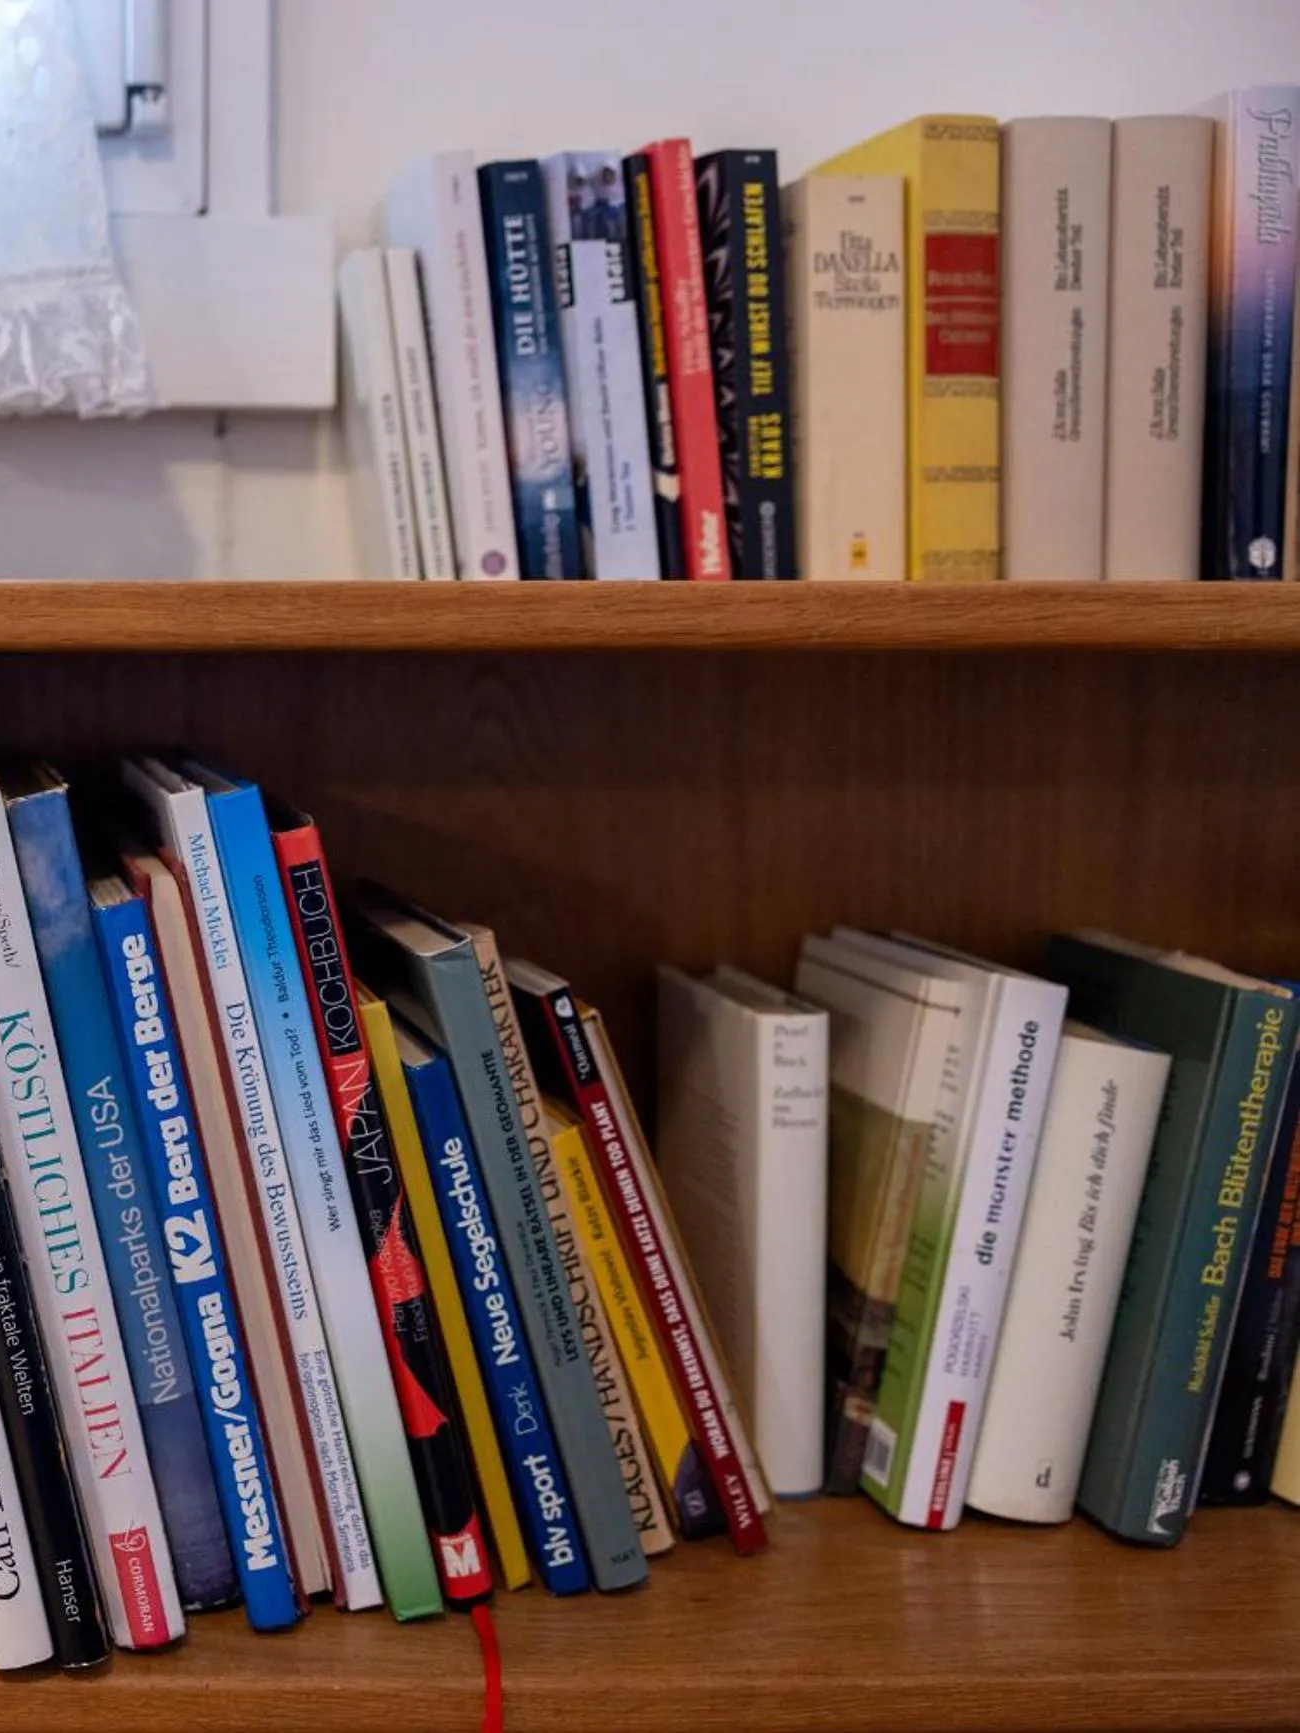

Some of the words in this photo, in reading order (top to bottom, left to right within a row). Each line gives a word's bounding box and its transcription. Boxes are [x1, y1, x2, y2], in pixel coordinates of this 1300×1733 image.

[503, 216, 530, 302] HÜTTE
[513, 313, 535, 355] DIE
[187, 833, 216, 901] Michael
[122, 934, 164, 1044] Berge
[294, 867, 356, 1049] KOCHBUCH
[225, 1001, 248, 1039] Die
[284, 1027, 302, 1057] Tod?
[480, 961, 539, 1129] CHARAKTER
[144, 1050, 178, 1110] der
[235, 1046, 266, 1137] Krönung
[295, 1059, 308, 1089] vom
[299, 1090, 316, 1118] Lied
[481, 1050, 513, 1132] GEOMANTIE
[86, 1076, 123, 1148] USA
[307, 1119, 321, 1143] das
[332, 1058, 392, 1182] JAPAN
[1218, 1009, 1282, 1207] Blütentherapie
[160, 1116, 198, 1204] Berg
[256, 1142, 278, 1177] des
[312, 1146, 326, 1168] mir
[505, 1134, 522, 1163] DER
[513, 1165, 527, 1182] IN
[528, 1136, 560, 1201] UND
[975, 1230, 996, 1265] die
[986, 1131, 1016, 1223] monster
[1006, 1020, 1038, 1121] methode
[106, 1152, 135, 1199] der
[318, 1169, 335, 1201] singt
[164, 1209, 215, 1283] K2
[326, 1204, 340, 1231] Wer
[441, 1138, 498, 1290] Segelschule
[266, 1183, 307, 1319] Bewusstseins
[533, 1236, 559, 1292] LINEARE
[1067, 1237, 1095, 1293] Irving
[1201, 1216, 1237, 1285] Bach
[119, 1207, 178, 1403] Nationalparks
[485, 1292, 519, 1365] Neue
[550, 1294, 569, 1327] UND
[1059, 1297, 1081, 1342] John
[560, 1328, 579, 1361] LEYS
[9, 1349, 34, 1415] Welten
[62, 1308, 126, 1478] ITALIEN
[507, 1382, 538, 1435] Denk
[198, 1293, 275, 1569] Messner/Gogna
[523, 1453, 564, 1520] sport
[725, 1474, 751, 1528] WILEY
[544, 1526, 573, 1566] blv
[55, 1558, 80, 1621] Hanser
[128, 1557, 153, 1631] CORMORAN
